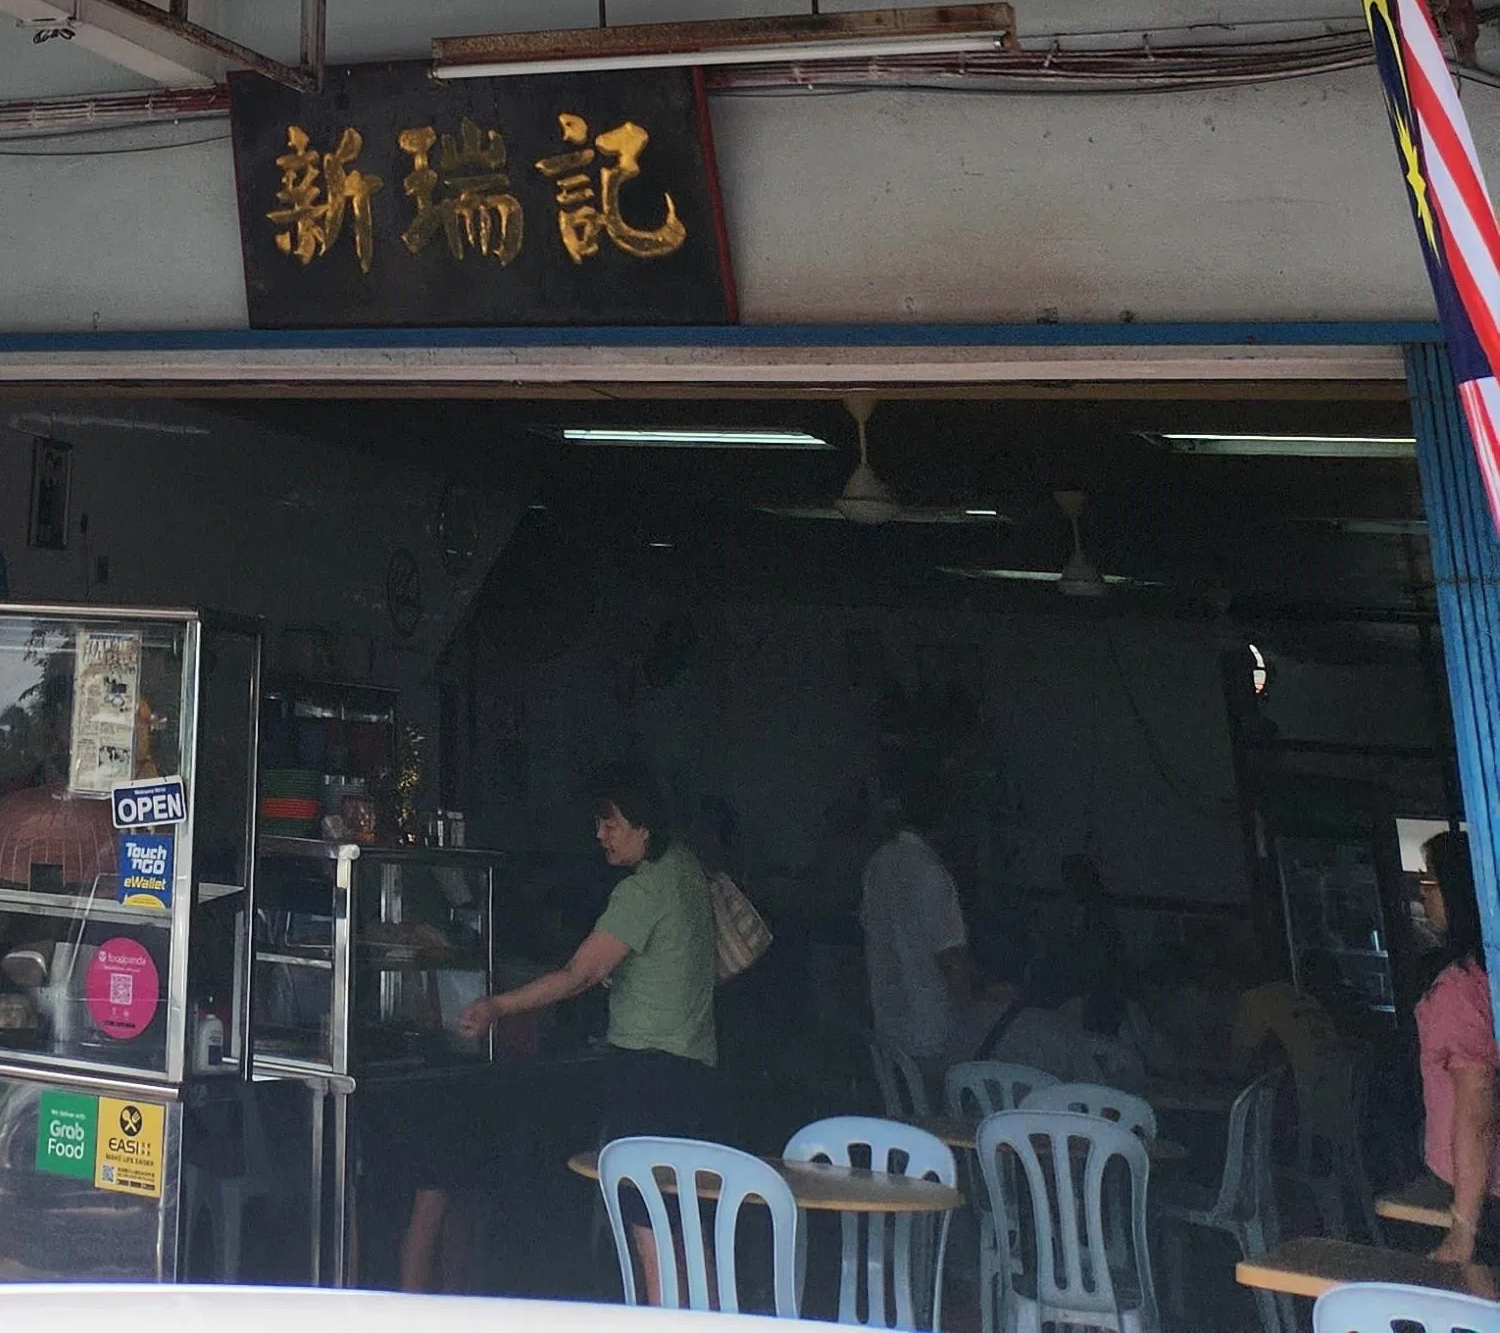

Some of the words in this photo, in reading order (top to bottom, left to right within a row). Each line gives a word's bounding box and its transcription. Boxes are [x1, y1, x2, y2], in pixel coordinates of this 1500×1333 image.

[117, 792, 182, 823] OPEN
[125, 842, 167, 860] Touch
[123, 876, 166, 891] eWallet
[49, 1119, 85, 1141] Grab
[47, 1137, 85, 1160] Food
